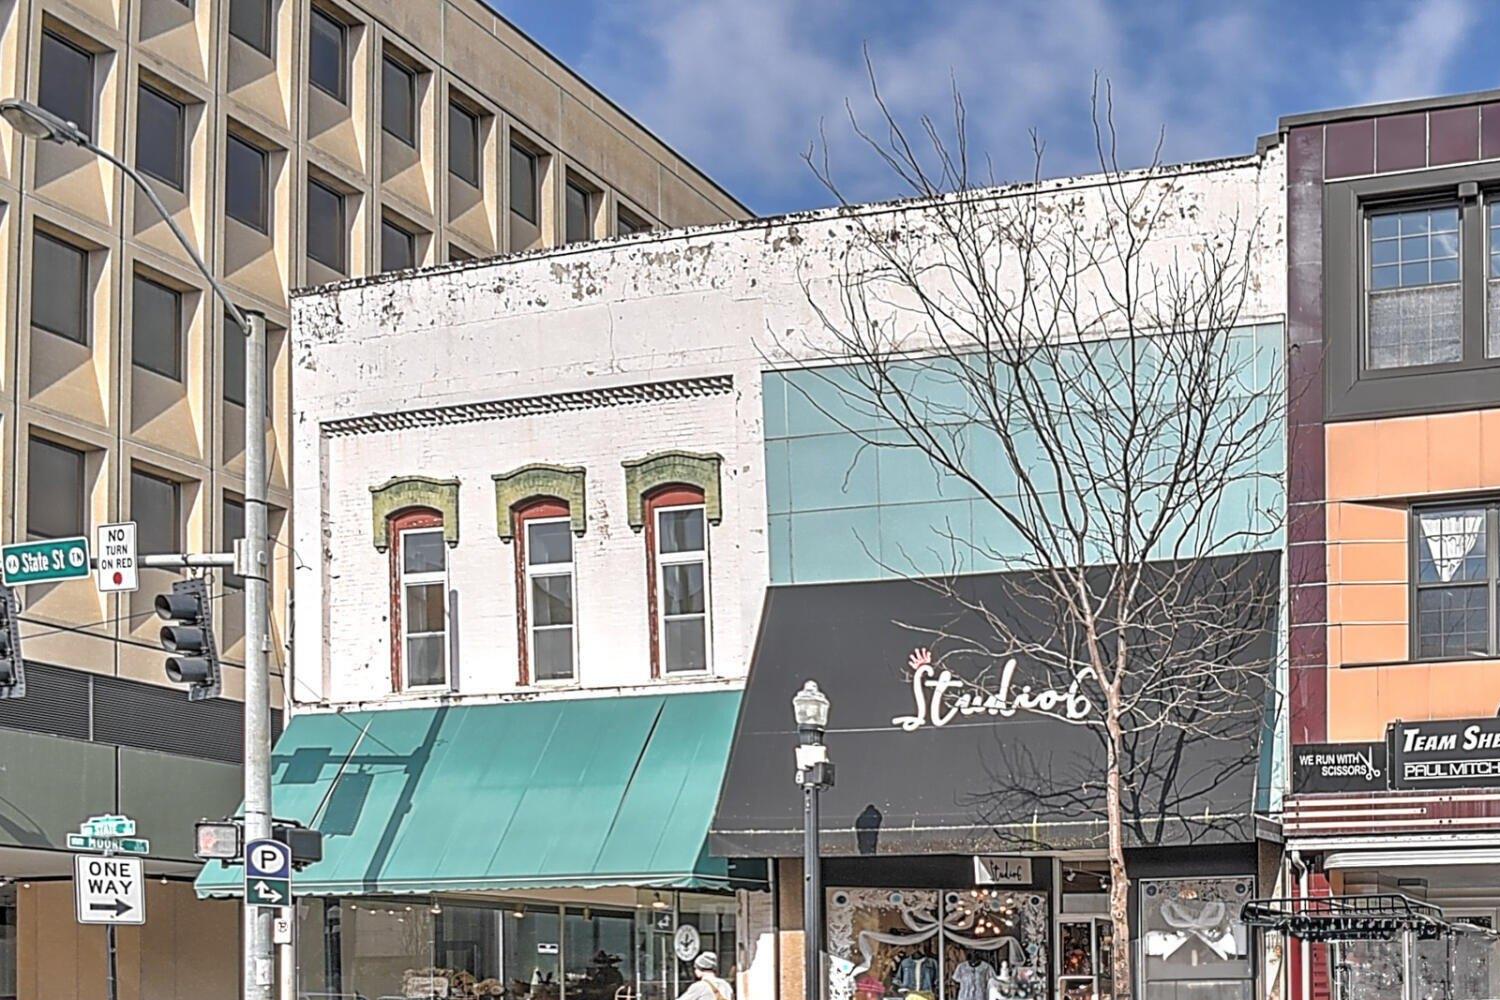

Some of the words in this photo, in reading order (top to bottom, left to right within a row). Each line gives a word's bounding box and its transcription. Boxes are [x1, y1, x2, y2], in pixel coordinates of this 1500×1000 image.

[108, 529, 125, 542] NO
[106, 546, 128, 555] TURN
[21, 552, 49, 573] State
[52, 549, 65, 570] St
[101, 560, 113, 570] ON
[116, 558, 133, 568] RED
[1299, 755, 1314, 766] WE
[1315, 755, 1335, 765] RUN
[1336, 754, 1360, 764] WITH
[1321, 765, 1367, 776] SCISSORS
[1404, 764, 1448, 777] PAUL
[261, 850, 277, 869] P
[89, 861, 131, 877] ONE
[88, 879, 133, 894] WAY
